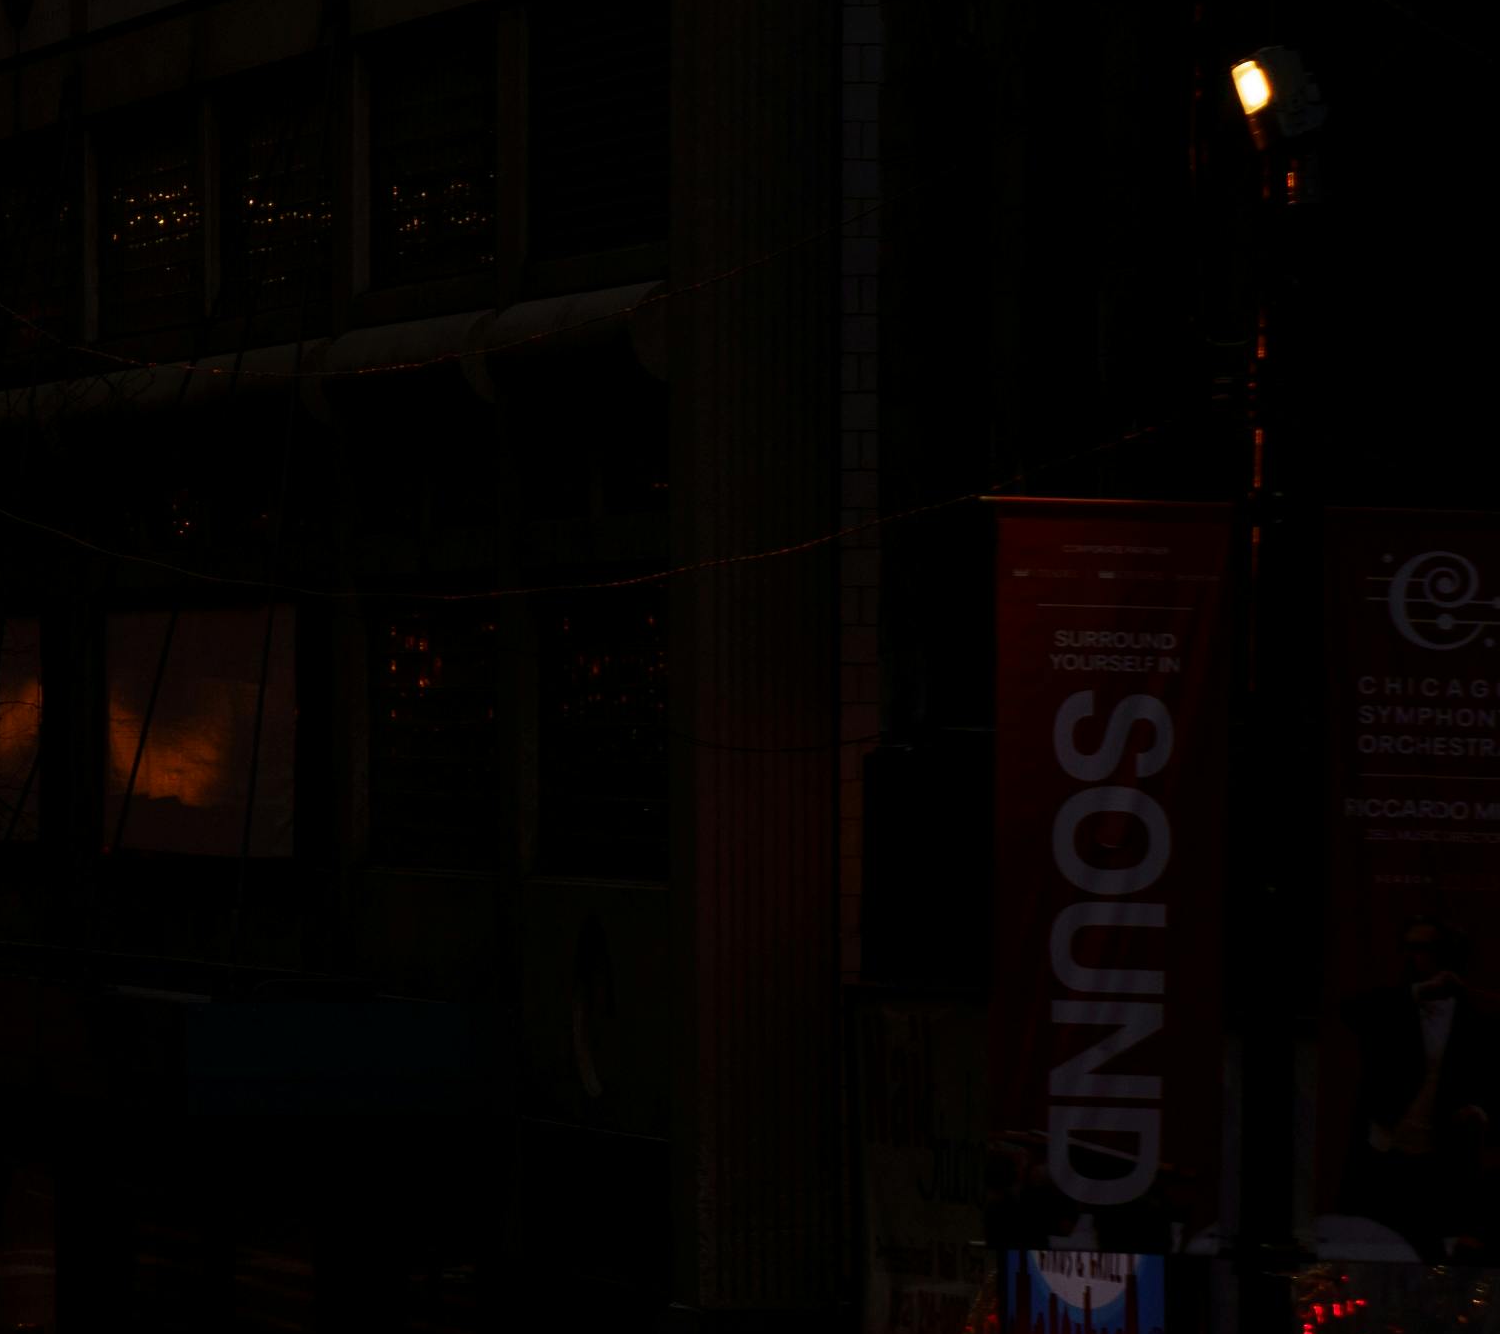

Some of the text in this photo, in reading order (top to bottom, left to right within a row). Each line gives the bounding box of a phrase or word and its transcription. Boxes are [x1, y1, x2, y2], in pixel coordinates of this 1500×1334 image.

[1052, 630, 1177, 651] SURROUND
[1049, 652, 1181, 673] YOURSELF IN
[1356, 705, 1500, 728] SYMPHON
[1047, 689, 1175, 1206] SOUND
